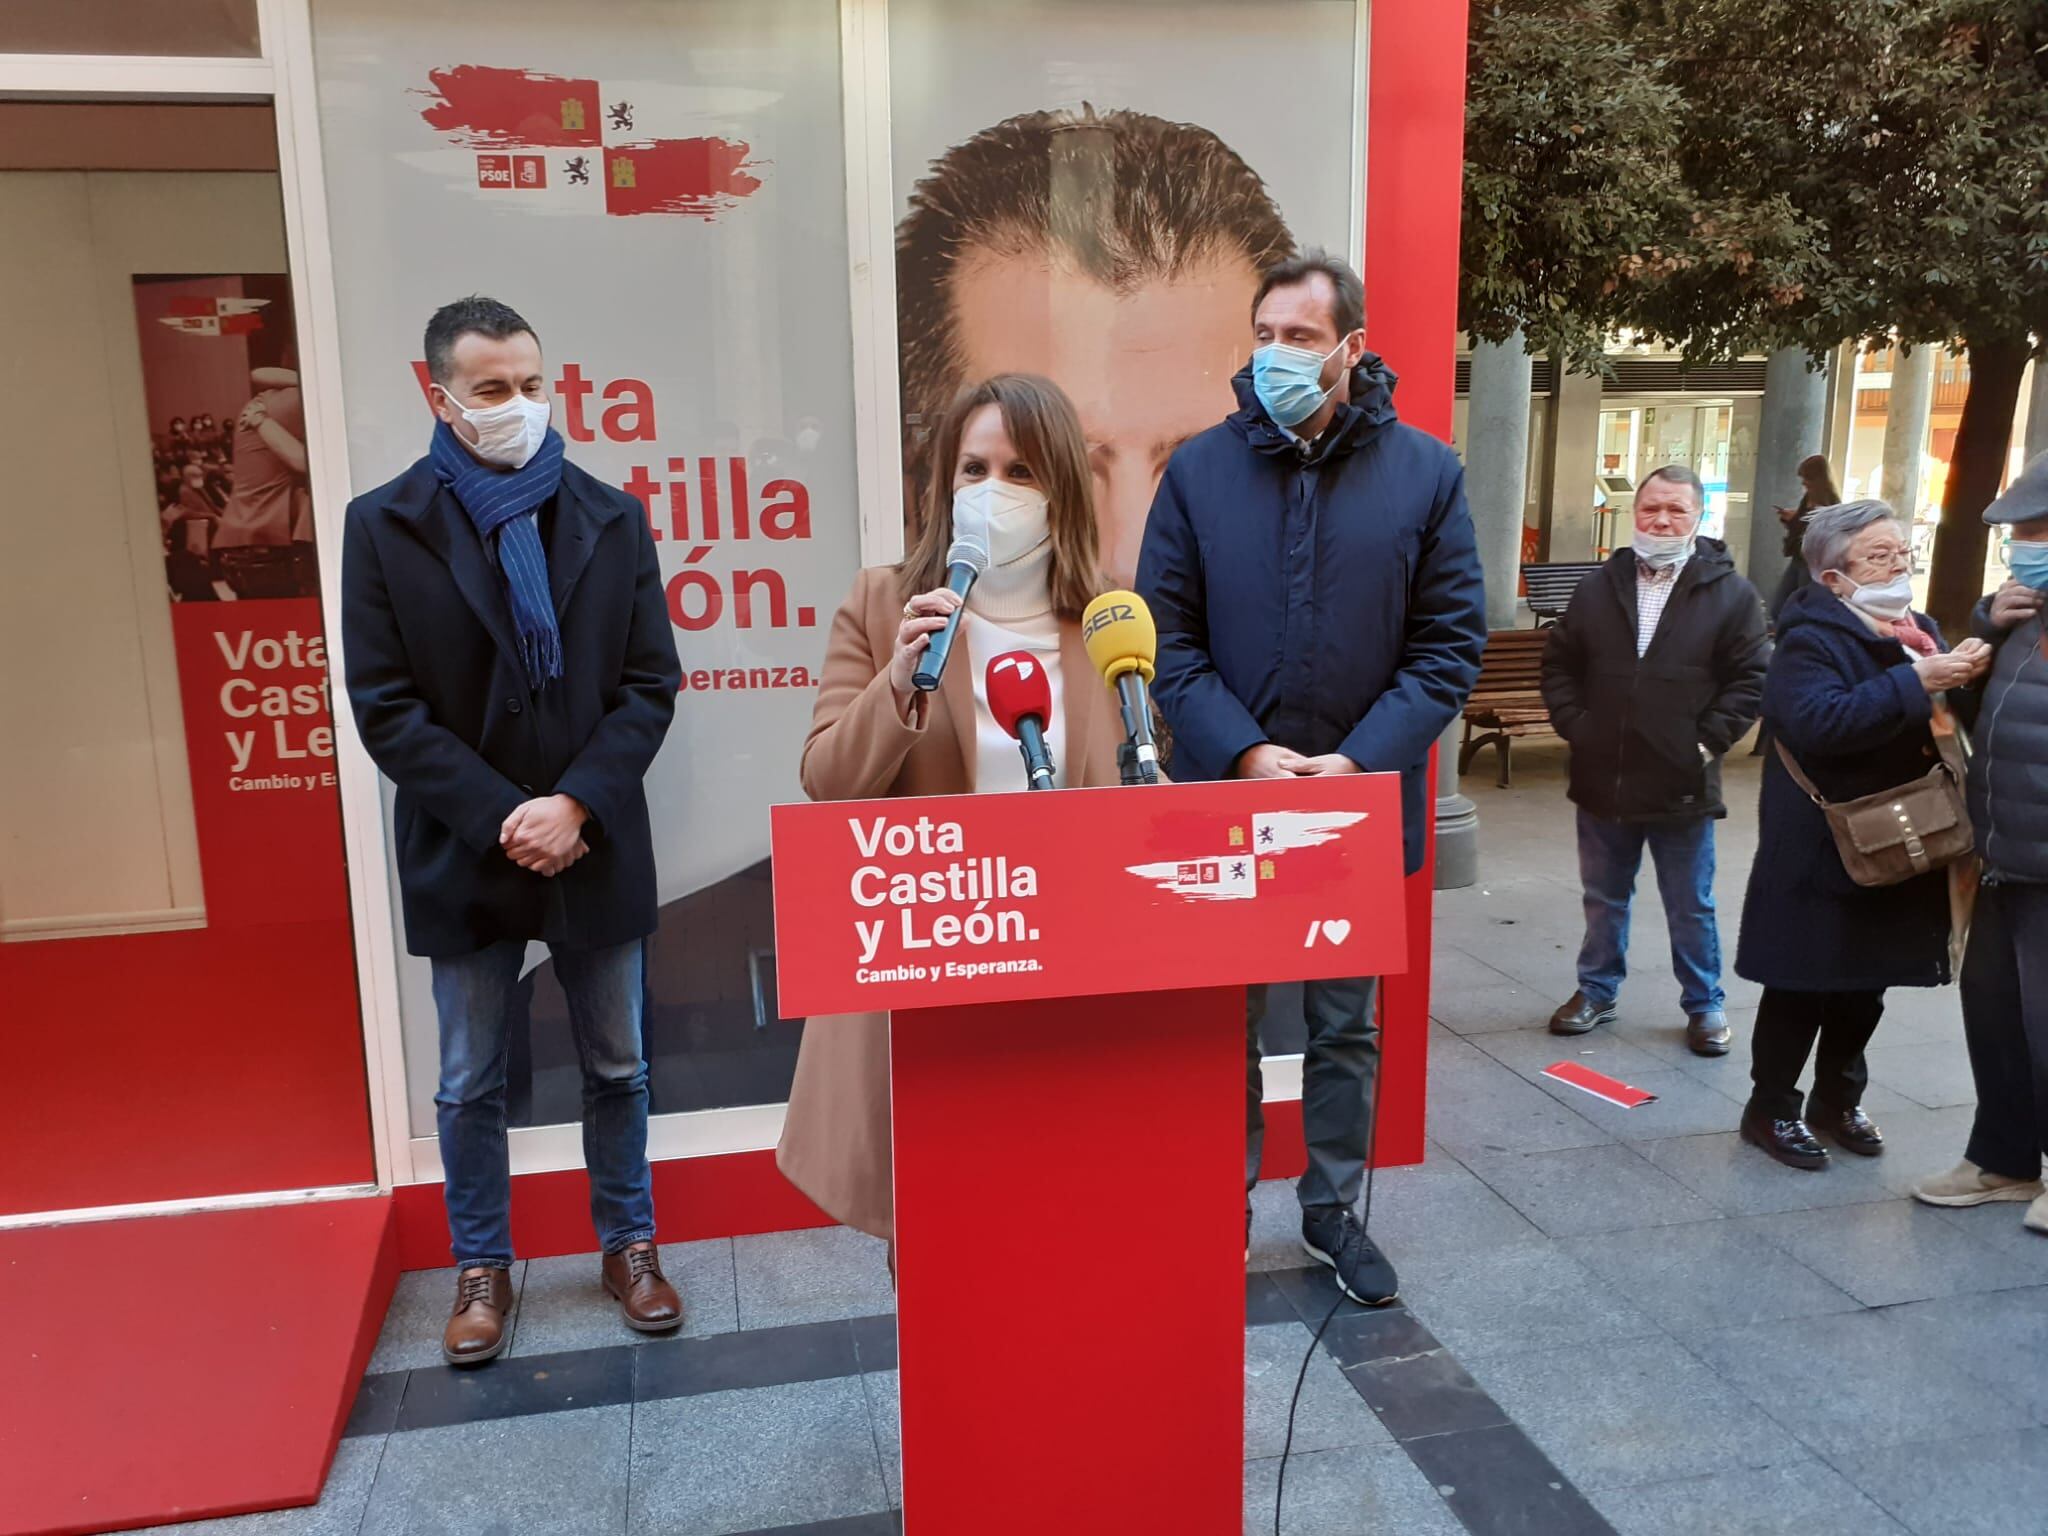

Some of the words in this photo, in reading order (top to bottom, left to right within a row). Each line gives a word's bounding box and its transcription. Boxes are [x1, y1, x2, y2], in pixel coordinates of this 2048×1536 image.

[480, 169, 510, 182] PSOE
[623, 456, 812, 542] tilla
[664, 545, 817, 632] ón.
[213, 630, 329, 671] Vota
[219, 676, 331, 719] Cast
[678, 666, 820, 692] eranza.
[224, 730, 255, 773] y
[229, 773, 302, 791] Cambio
[305, 774, 317, 791] y
[848, 816, 964, 858] Vota
[850, 856, 1038, 907] Castilla
[854, 919, 885, 964] y
[901, 900, 1040, 950] León.
[855, 964, 927, 984] Cambio
[930, 966, 942, 982] y
[944, 958, 1043, 979] Esperanza.
